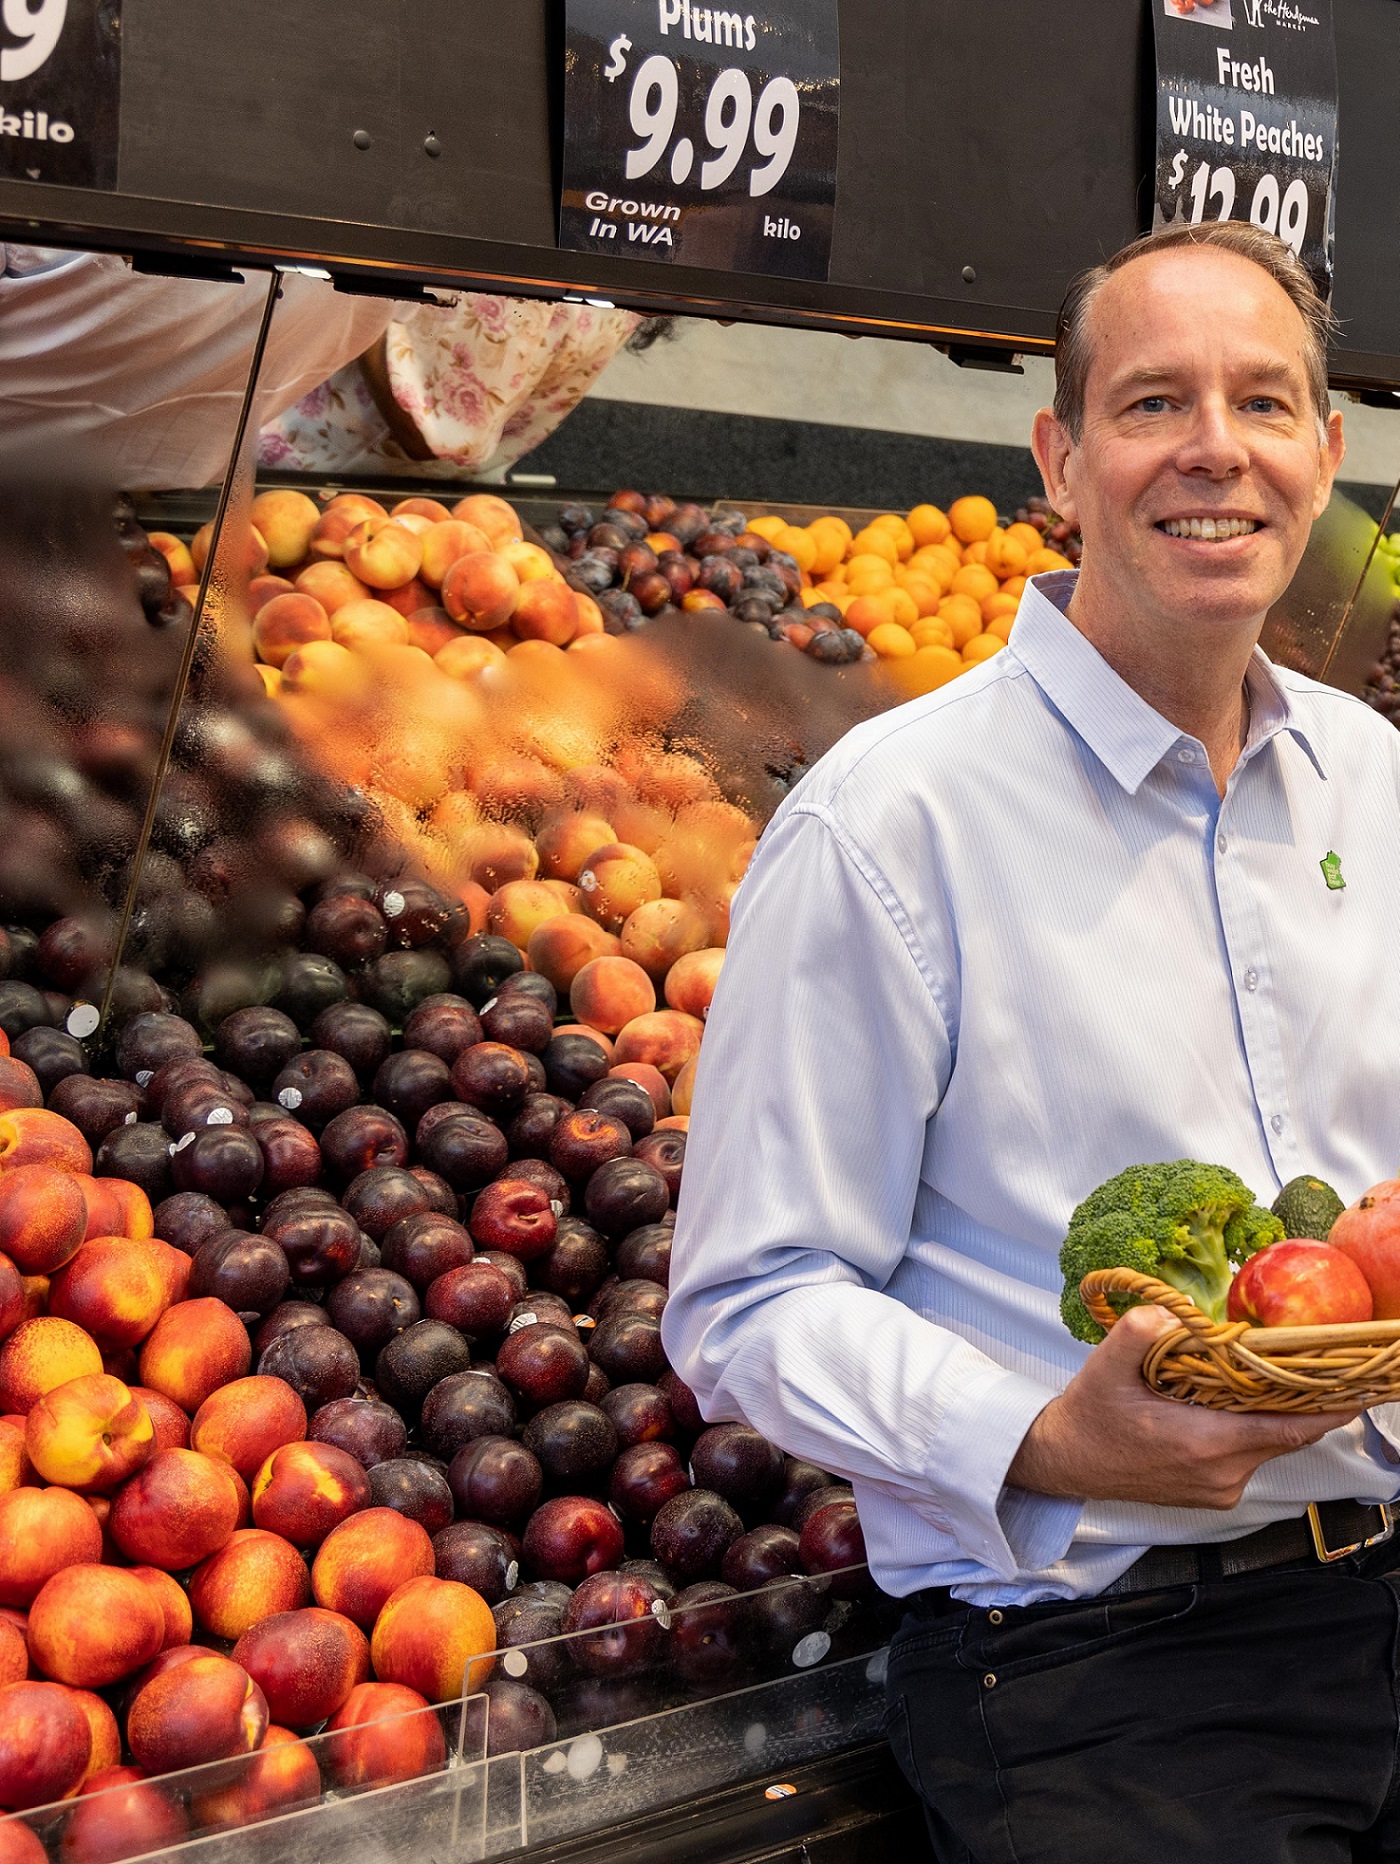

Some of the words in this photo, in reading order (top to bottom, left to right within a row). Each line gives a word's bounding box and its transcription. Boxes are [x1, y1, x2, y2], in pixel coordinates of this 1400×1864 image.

[658, 0, 757, 51] Plums
[1216, 47, 1275, 95] Fresh
[1169, 96, 1235, 145] White
[1240, 110, 1324, 162] Peaches
[585, 191, 681, 221] Grown
[589, 218, 618, 238] In
[628, 222, 673, 246] WA
[763, 215, 801, 241] kilo
